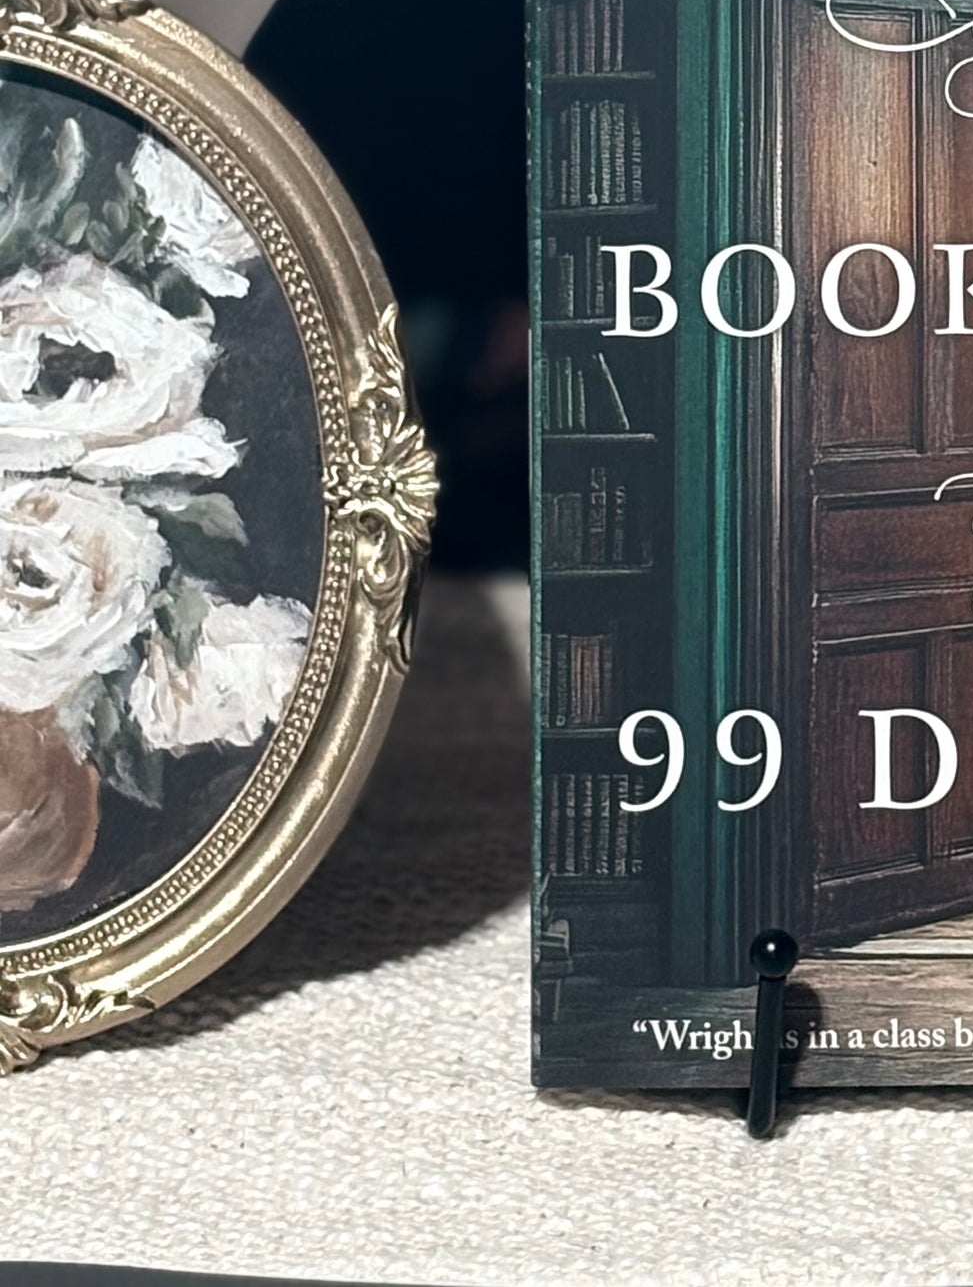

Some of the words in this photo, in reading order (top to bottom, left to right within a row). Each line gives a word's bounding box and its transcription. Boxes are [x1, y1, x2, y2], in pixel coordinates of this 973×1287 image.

[617, 708, 784, 814] 99
[632, 1018, 760, 1061] “Wrigh
[807, 1020, 841, 1050] in
[847, 1028, 867, 1050] a
[871, 1017, 947, 1049] class
